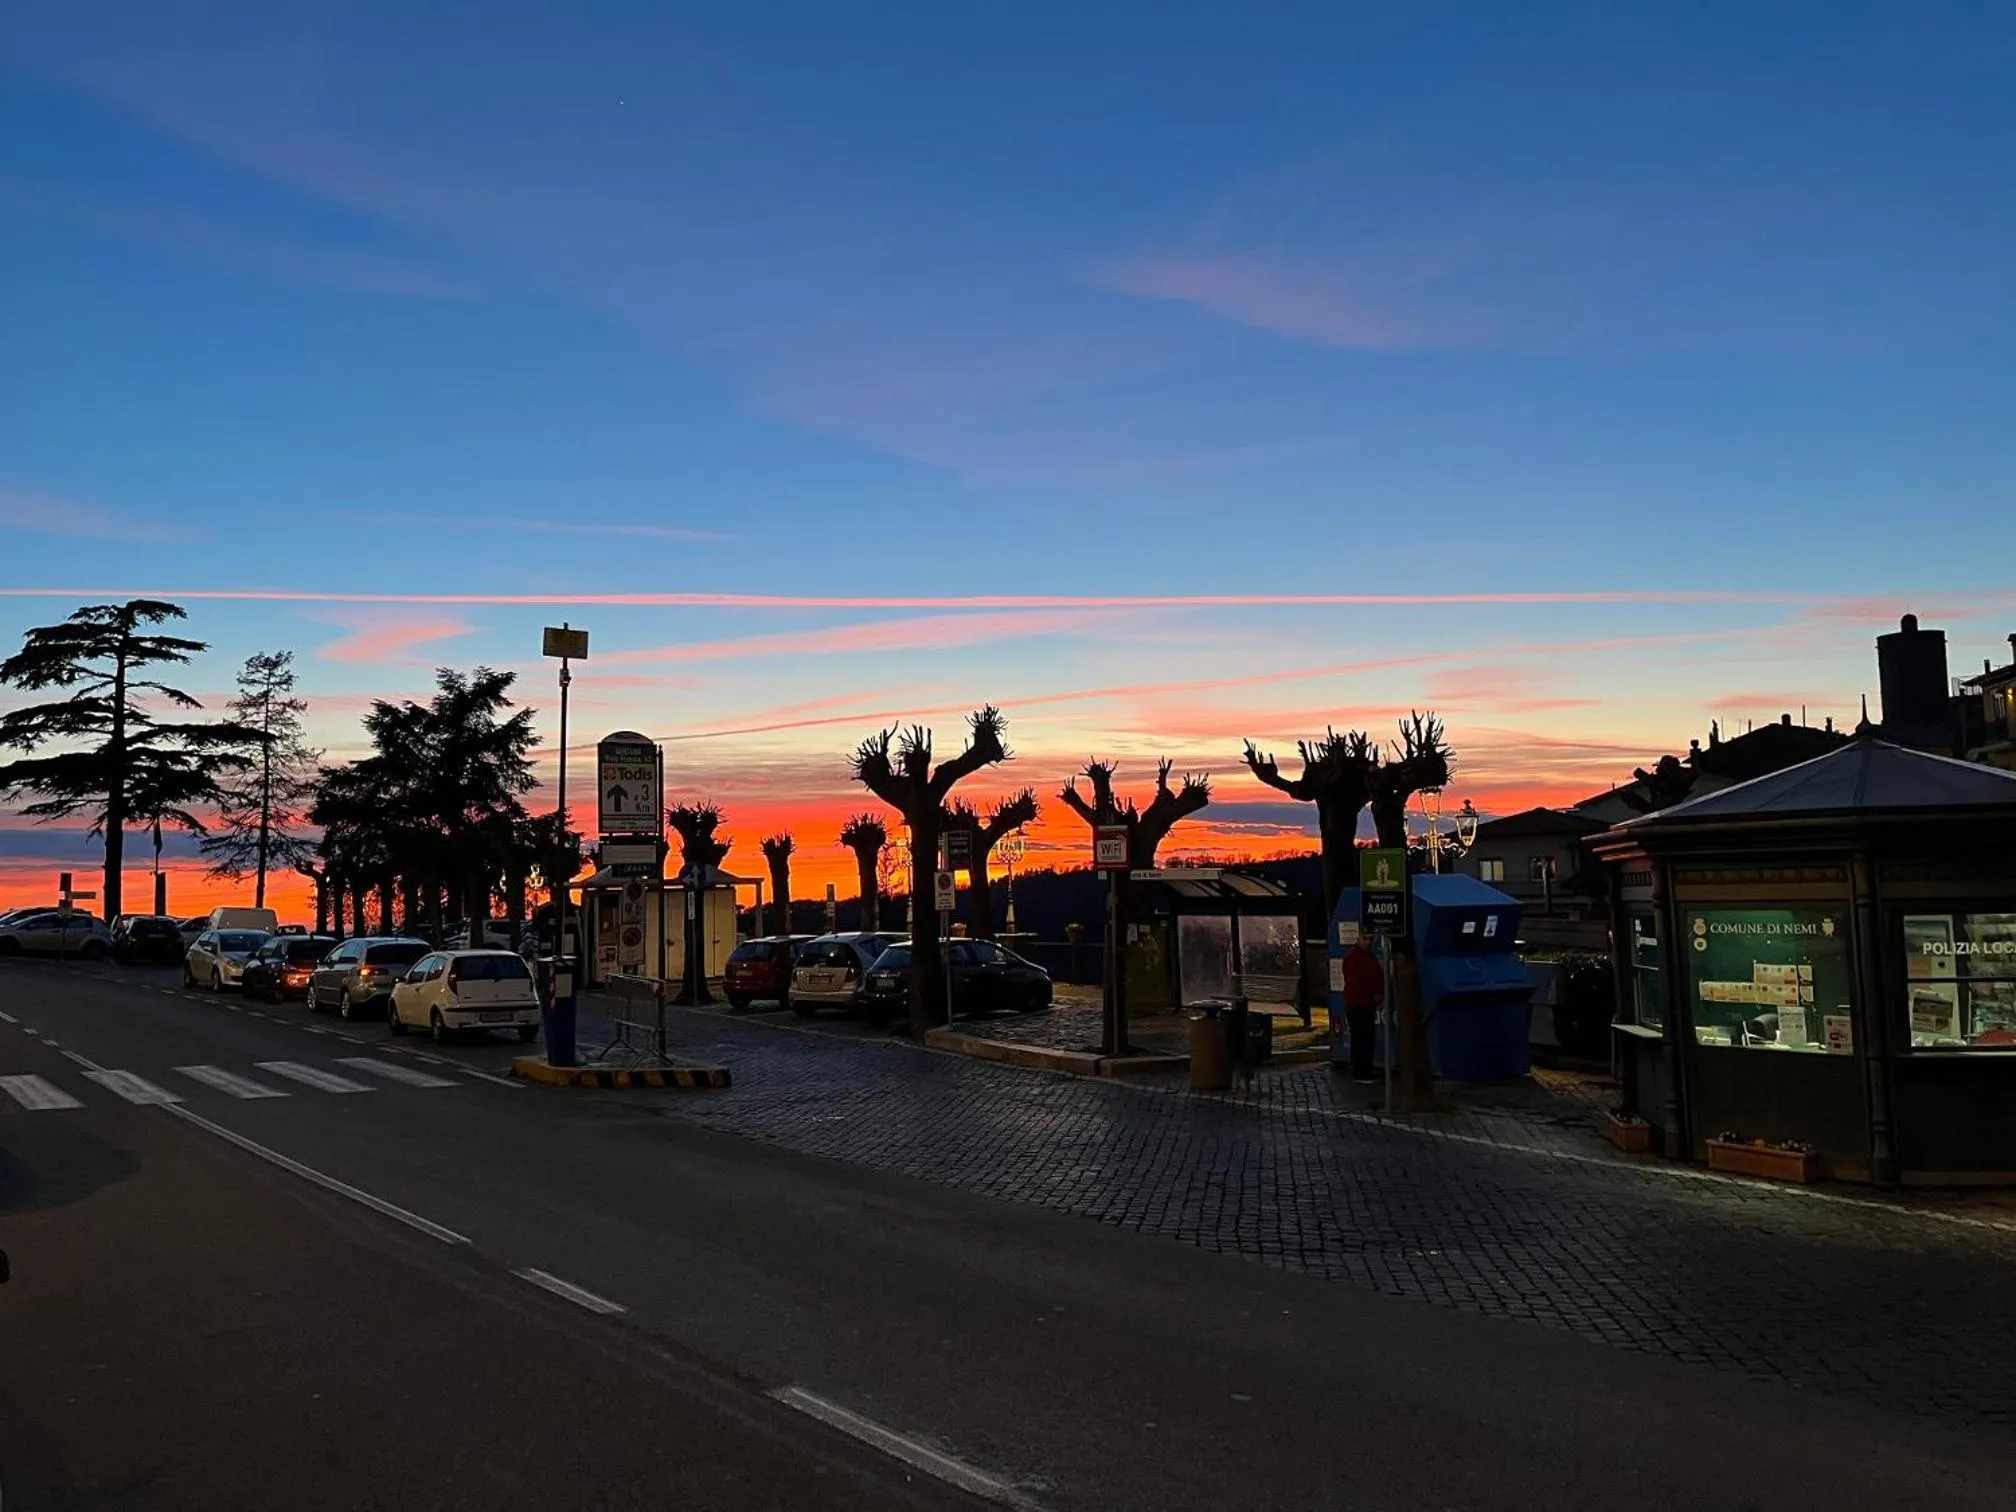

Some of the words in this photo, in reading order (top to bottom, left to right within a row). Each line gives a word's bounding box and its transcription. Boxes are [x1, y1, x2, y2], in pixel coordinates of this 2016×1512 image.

[618, 767, 652, 780] Todis
[642, 784, 649, 801] 3
[1367, 902, 1399, 915] AA001
[1710, 923, 1764, 934] COMUNE
[1767, 924, 1780, 934] DI
[1784, 923, 1817, 935] NEMI
[1922, 941, 1980, 955] POLIZIA
